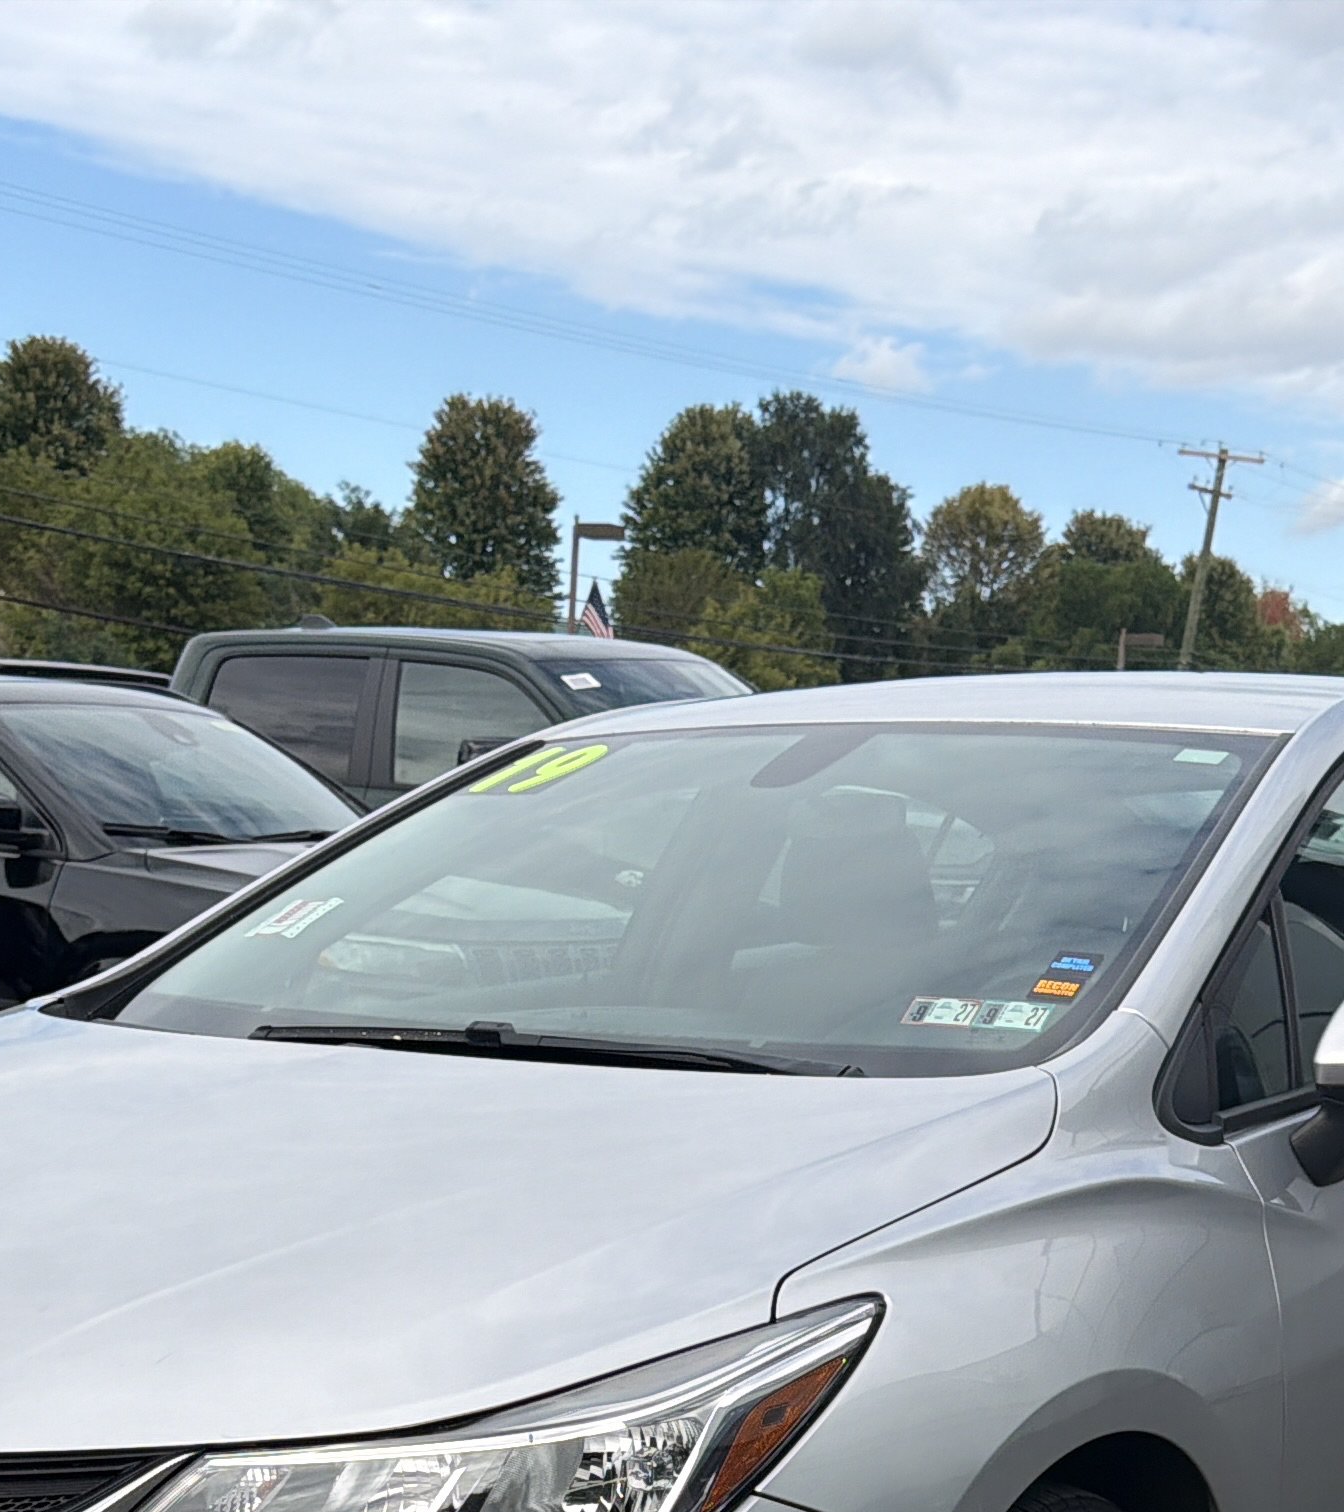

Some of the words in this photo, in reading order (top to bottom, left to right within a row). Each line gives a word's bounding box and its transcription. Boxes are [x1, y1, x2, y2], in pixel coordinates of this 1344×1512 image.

[468, 744, 608, 792] 19
[1036, 979, 1080, 992] RECON
[953, 1003, 977, 1022] 27
[1024, 1007, 1048, 1026] 27
